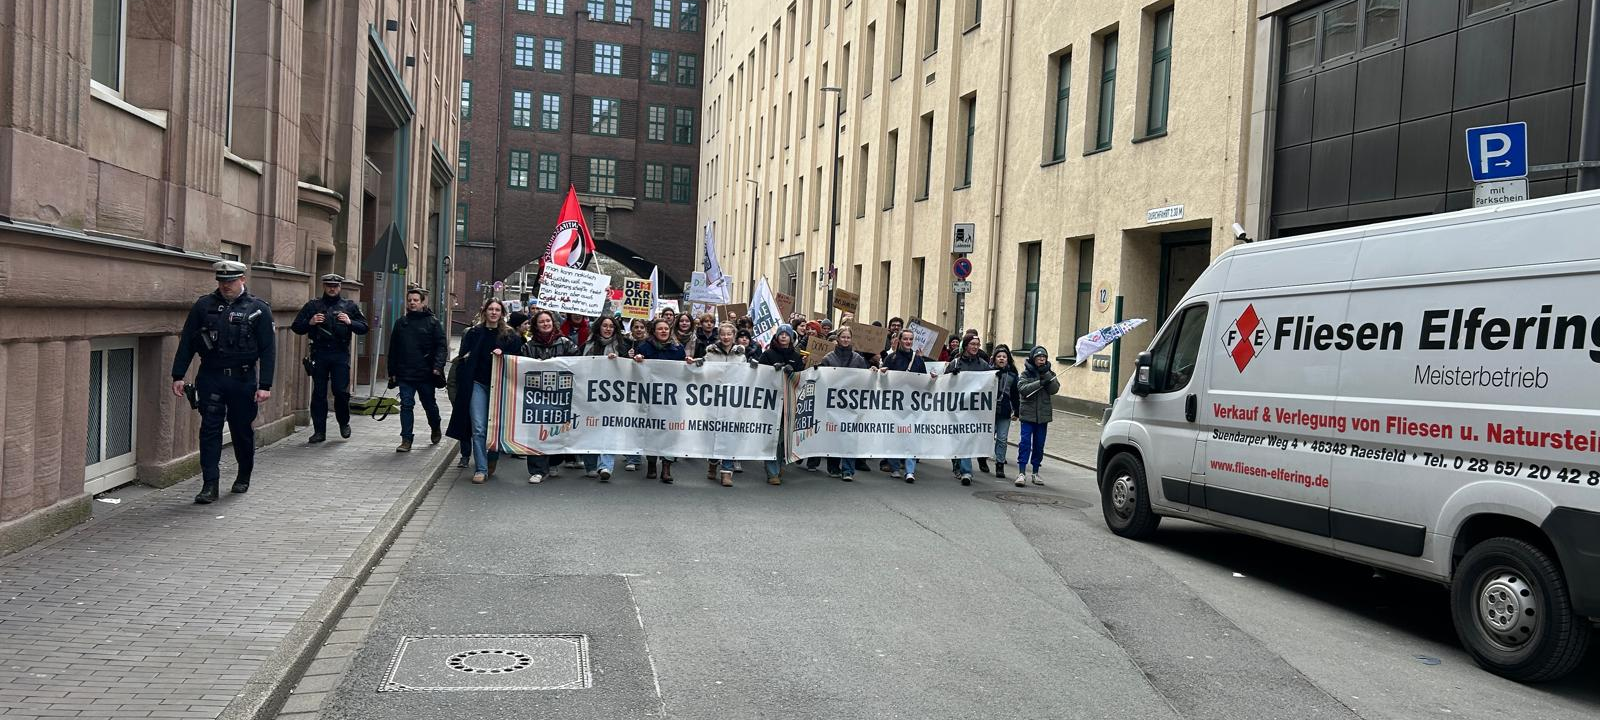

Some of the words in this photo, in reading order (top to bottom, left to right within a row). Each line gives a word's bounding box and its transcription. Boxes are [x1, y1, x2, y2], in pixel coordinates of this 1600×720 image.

[1480, 132, 1512, 174] P
[1476, 194, 1524, 204] Parkschein
[1099, 289, 1107, 303] 12
[1227, 331, 1236, 346] F
[1254, 329, 1264, 346] E
[1273, 315, 1404, 350] Fliesen
[1414, 364, 1548, 389] Meisterbetrieb
[525, 390, 571, 406] SCHULE
[587, 380, 678, 406] ESSENER
[685, 382, 778, 410] SCHULEN
[826, 388, 904, 411] ESSENER
[911, 390, 992, 412] SCHULEN
[525, 408, 570, 424] BLEIBT
[538, 414, 580, 441] bunt
[586, 416, 598, 427] für
[602, 416, 666, 430] DEMOKRATIE
[668, 419, 685, 431] und
[688, 420, 773, 435] MENSCHENRECHTE
[826, 422, 838, 432] für
[840, 422, 895, 434] DEMOKRATIE
[897, 423, 912, 433] und
[914, 423, 992, 434] MENSCHENRECHTE
[1214, 403, 1258, 421] Verkauf
[1262, 407, 1271, 422] &
[1275, 408, 1346, 432] Verlegung
[1352, 417, 1380, 432] von
[1386, 416, 1453, 439] Fliesen
[1460, 426, 1478, 441] u.
[1213, 429, 1266, 446] Suendarper
[1267, 435, 1288, 450] Weg
[1291, 439, 1298, 449] 4
[1311, 440, 1347, 455] 46348
[1350, 444, 1406, 463] Raesfeld
[1423, 452, 1447, 468] Tel.
[1453, 456, 1463, 469] 0
[1468, 458, 1489, 472] 28
[1494, 460, 1523, 477] 65/
[1527, 464, 1552, 480] 20
[1556, 468, 1582, 484] 42
[1210, 458, 1329, 487] www.fliesen-elfering.de
